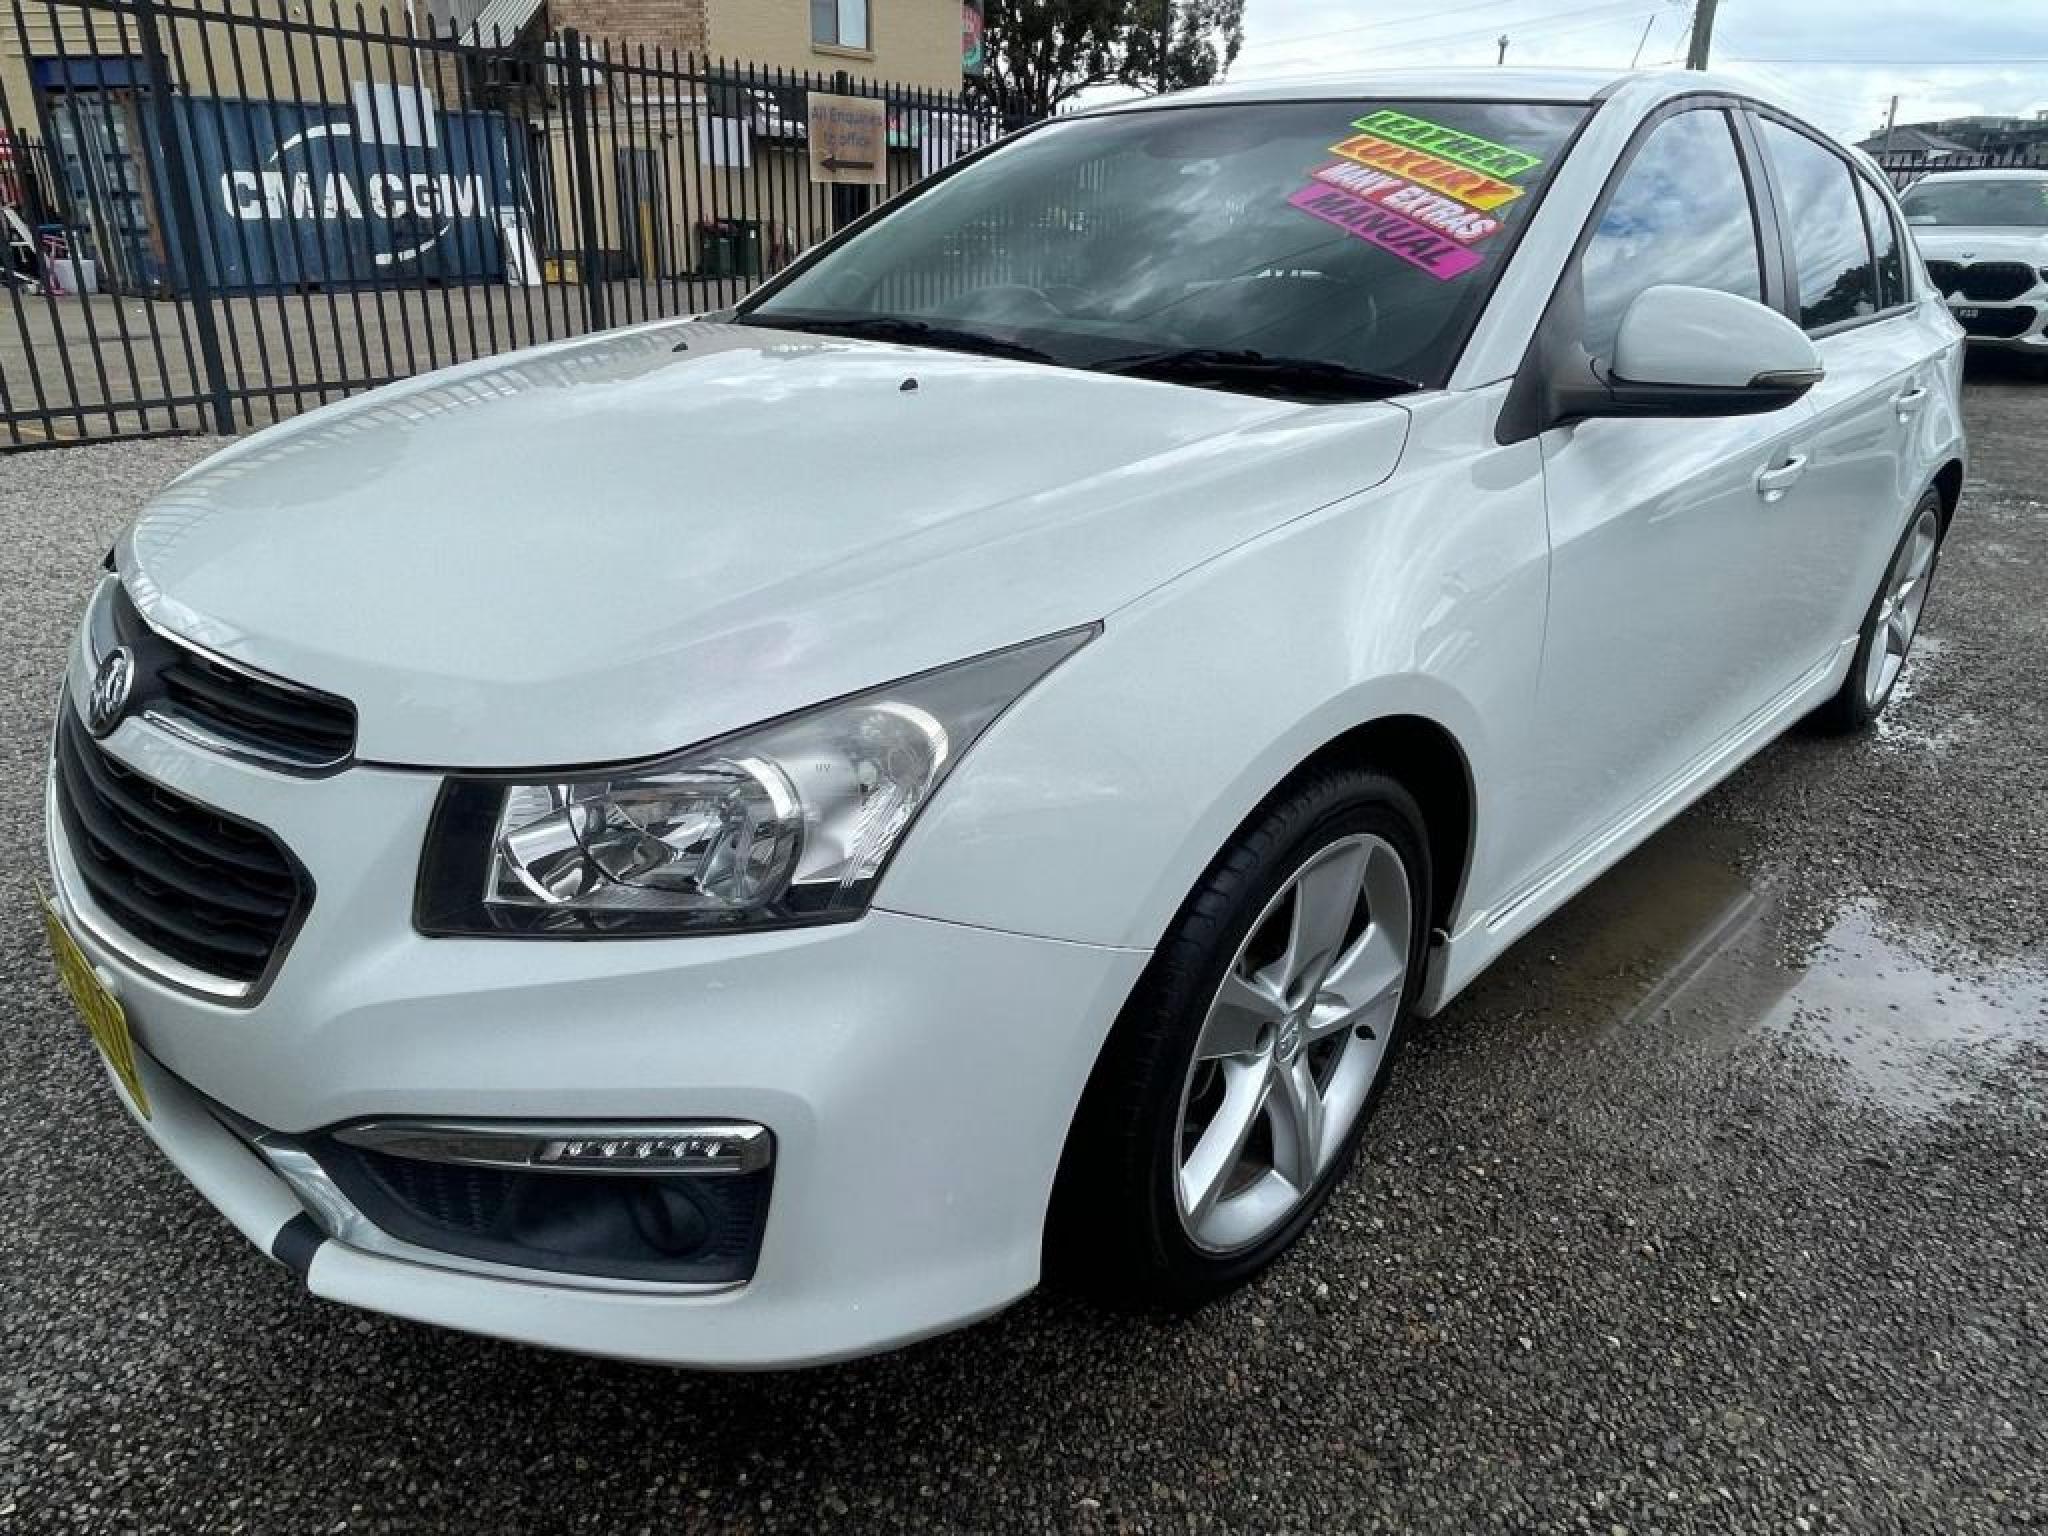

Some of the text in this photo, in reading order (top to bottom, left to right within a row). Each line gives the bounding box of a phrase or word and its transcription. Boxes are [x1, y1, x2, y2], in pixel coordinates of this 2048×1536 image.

[1341, 135, 1512, 198] LUXURY
[1354, 112, 1531, 176] LEATHER
[221, 171, 487, 219] CMA CGM
[1303, 191, 1458, 267] MANUAL
